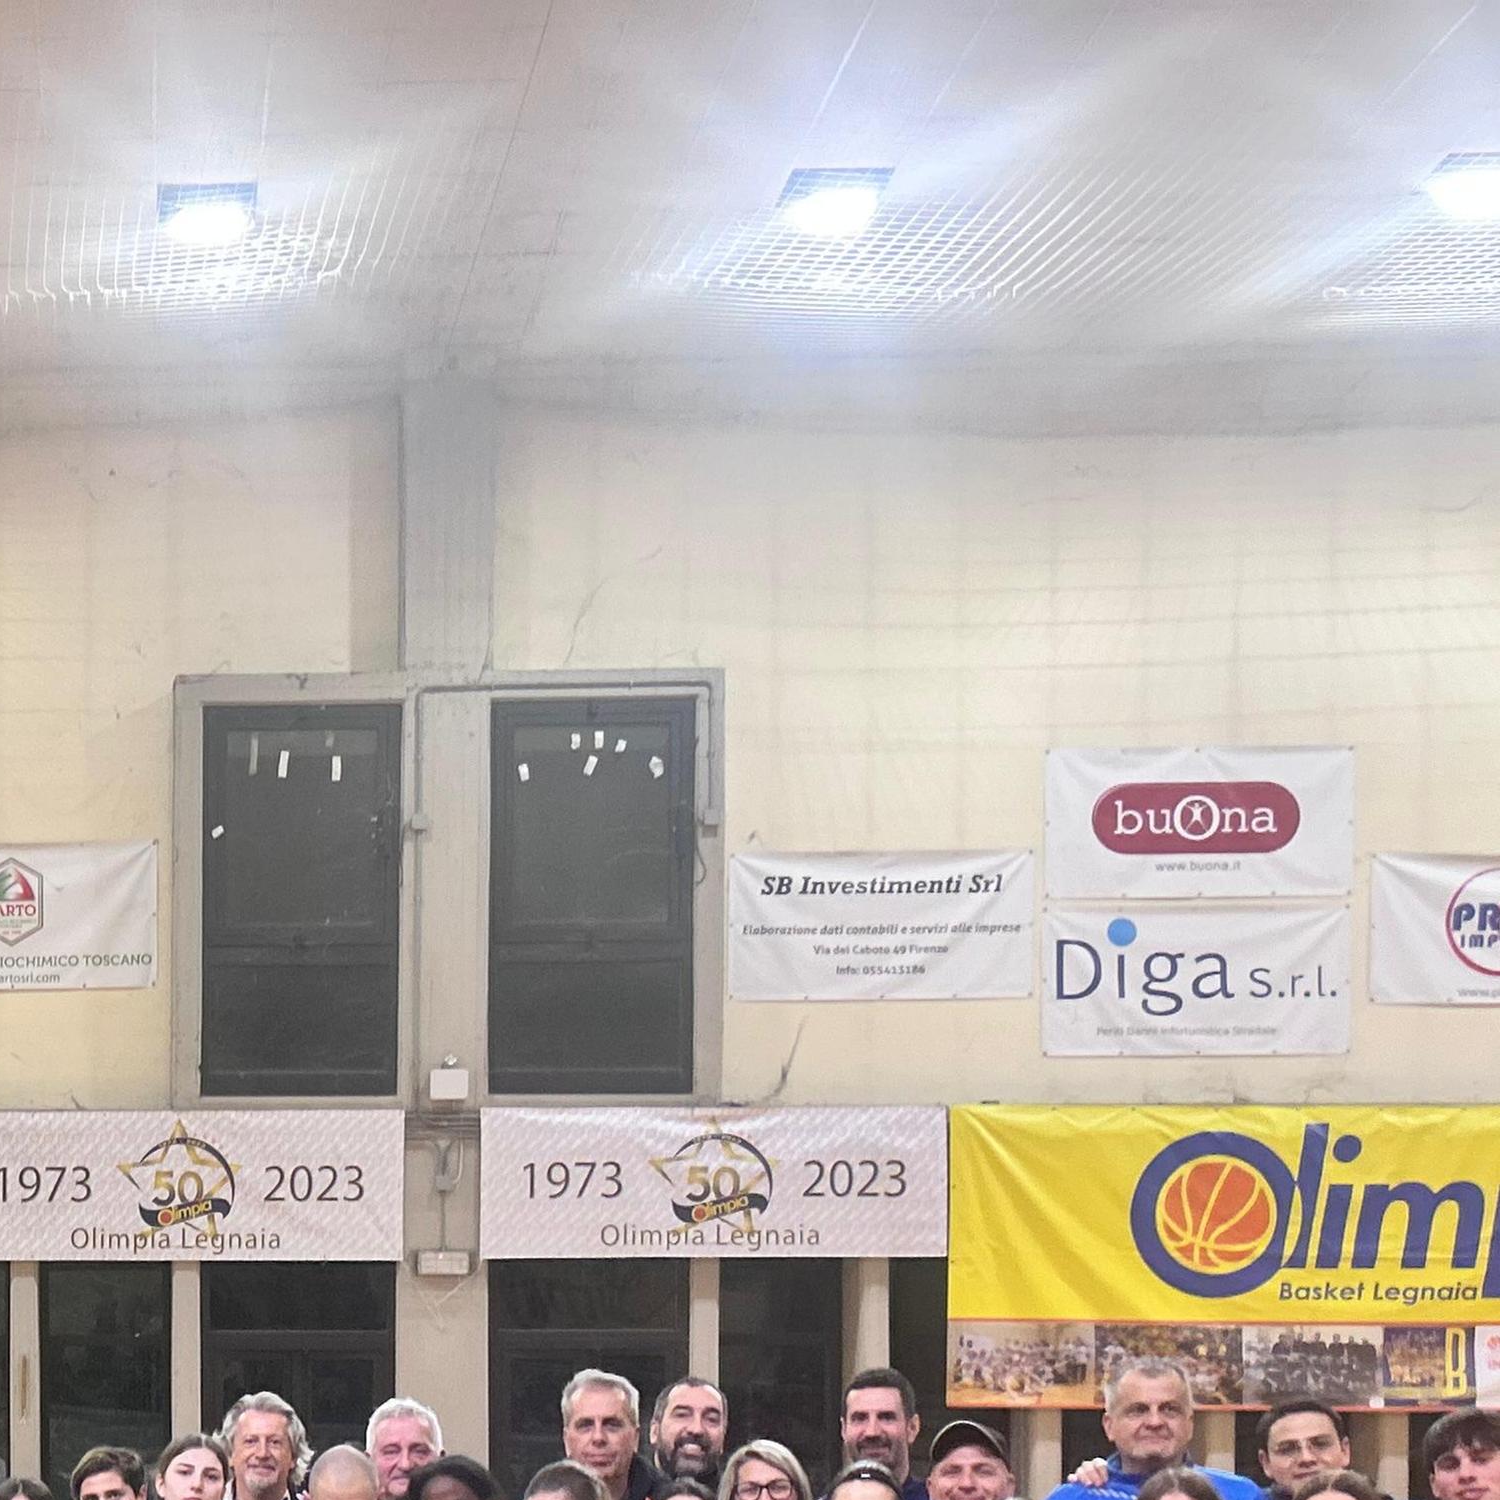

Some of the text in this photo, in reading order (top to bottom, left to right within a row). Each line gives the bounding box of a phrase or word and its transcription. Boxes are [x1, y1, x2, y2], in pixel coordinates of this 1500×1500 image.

[1154, 860, 1242, 872] www.buona.it
[761, 874, 1003, 895] SB Investimenti Srl
[742, 924, 1021, 936] Elaborazione dati contabili e servizi alle imprese
[83, 953, 153, 967] TOSCANO
[813, 945, 831, 955] Via
[909, 944, 949, 955] Firenze
[836, 965, 860, 976] Info:
[1056, 918, 1338, 1016] Diga s.r.l.
[152, 1171, 203, 1206] 50
[263, 1165, 366, 1202] 2023
[523, 1159, 908, 1202] 1973 50 2023
[158, 1201, 212, 1226] Olimpia
[1130, 1122, 1500, 1299] Olim
[70, 1227, 281, 1254] Olimpia Legnaia
[600, 1223, 821, 1251] Olimpia Legnaia
[1279, 1282, 1478, 1305] Basket Legnaia
